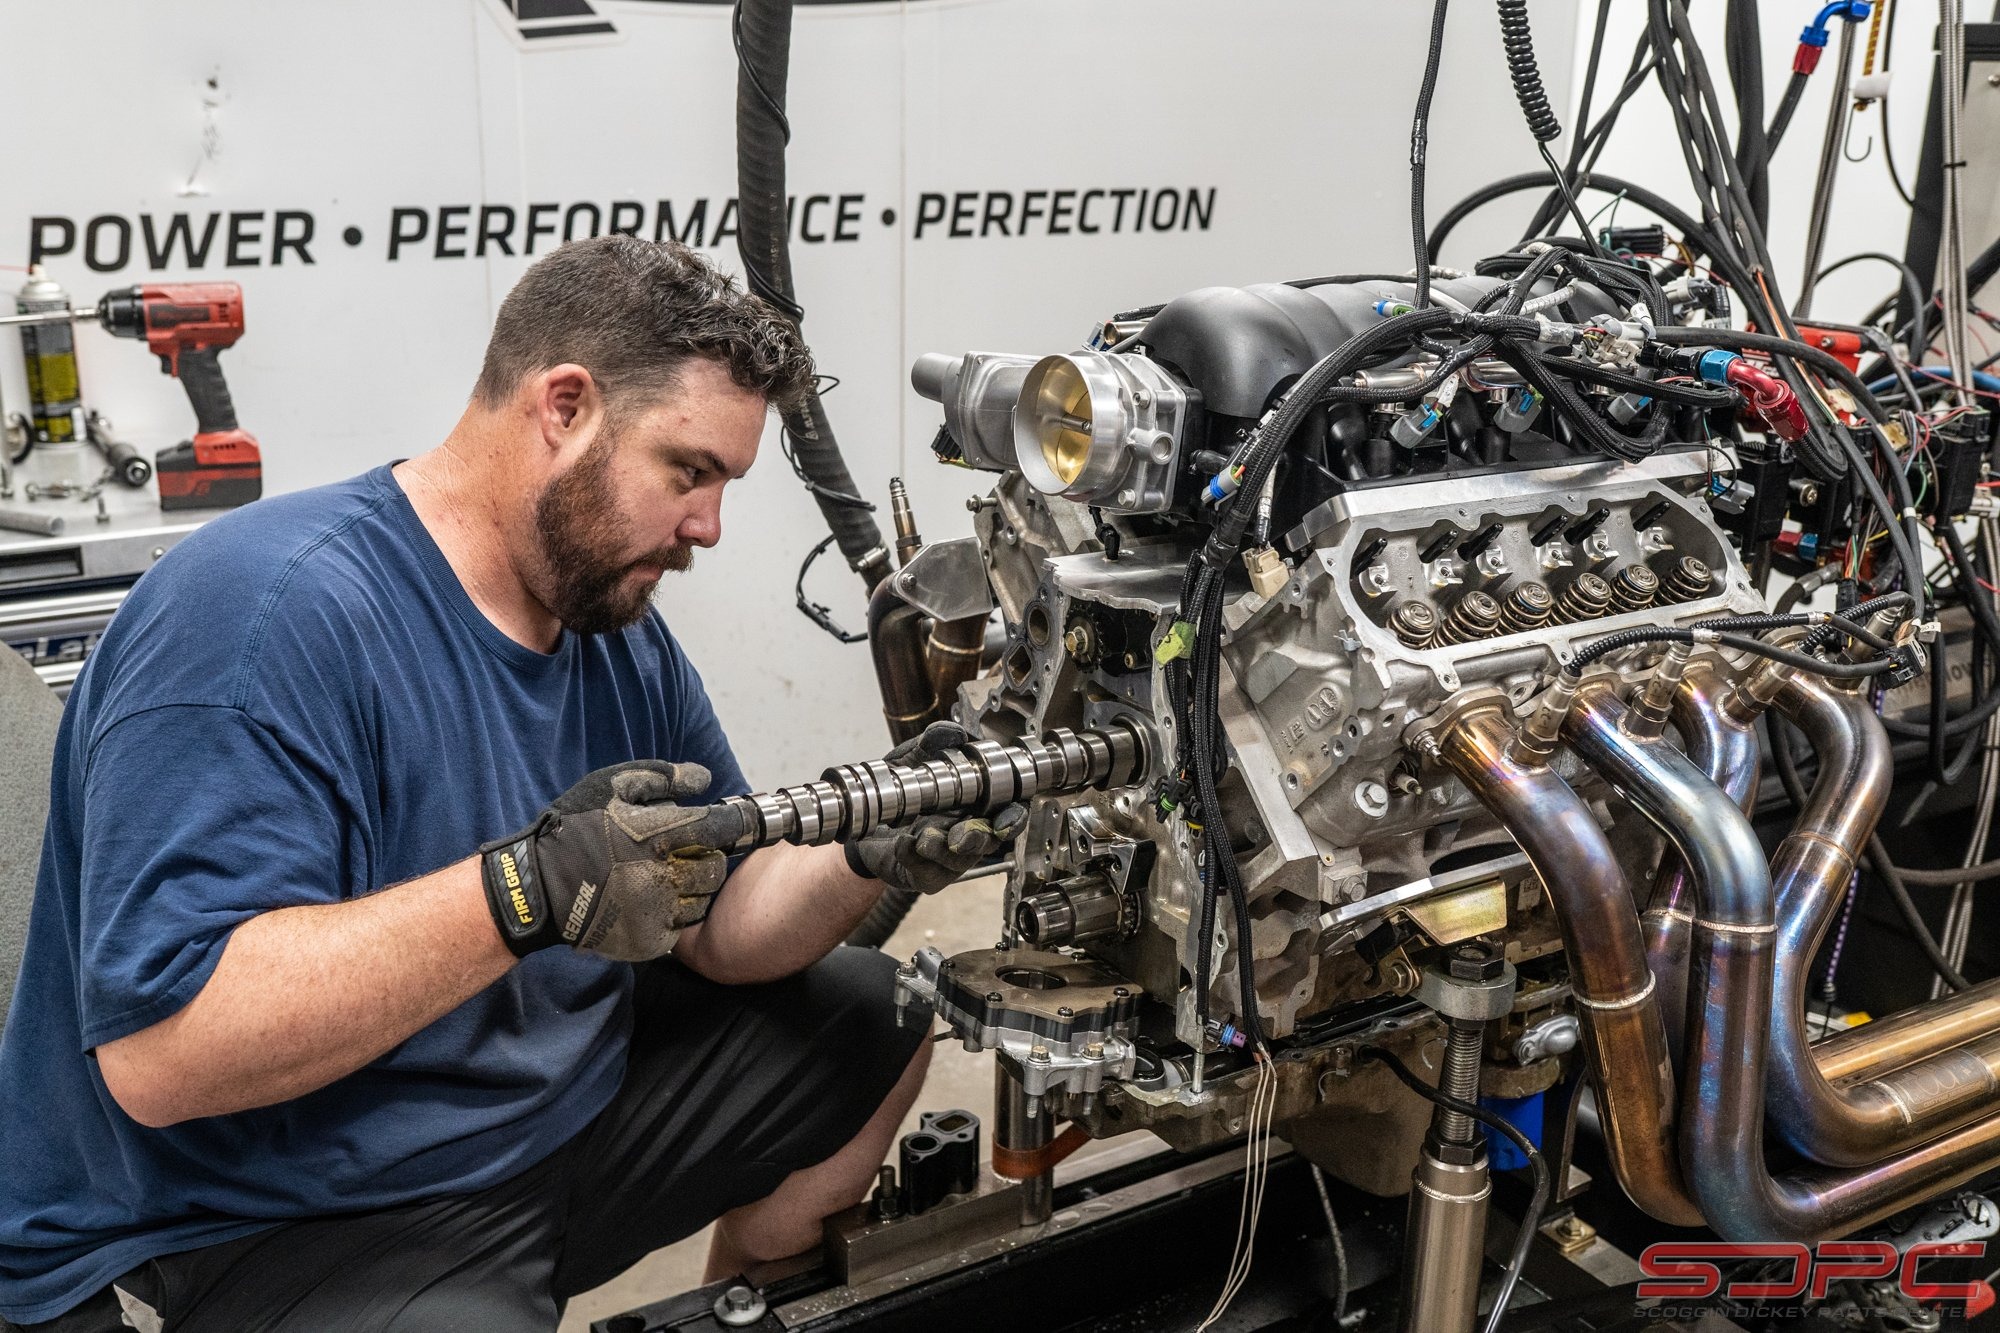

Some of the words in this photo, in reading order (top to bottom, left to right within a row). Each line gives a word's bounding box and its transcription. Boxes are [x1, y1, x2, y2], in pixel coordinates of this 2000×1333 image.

[30, 211, 316, 273] POWER
[387, 194, 866, 261] PERFORMACE
[914, 188, 1217, 239] PERFECTION
[500, 852, 521, 888] GRIP
[510, 887, 533, 924] FIRM
[562, 880, 597, 942] GENERAL
[582, 900, 624, 950] PURPOSE
